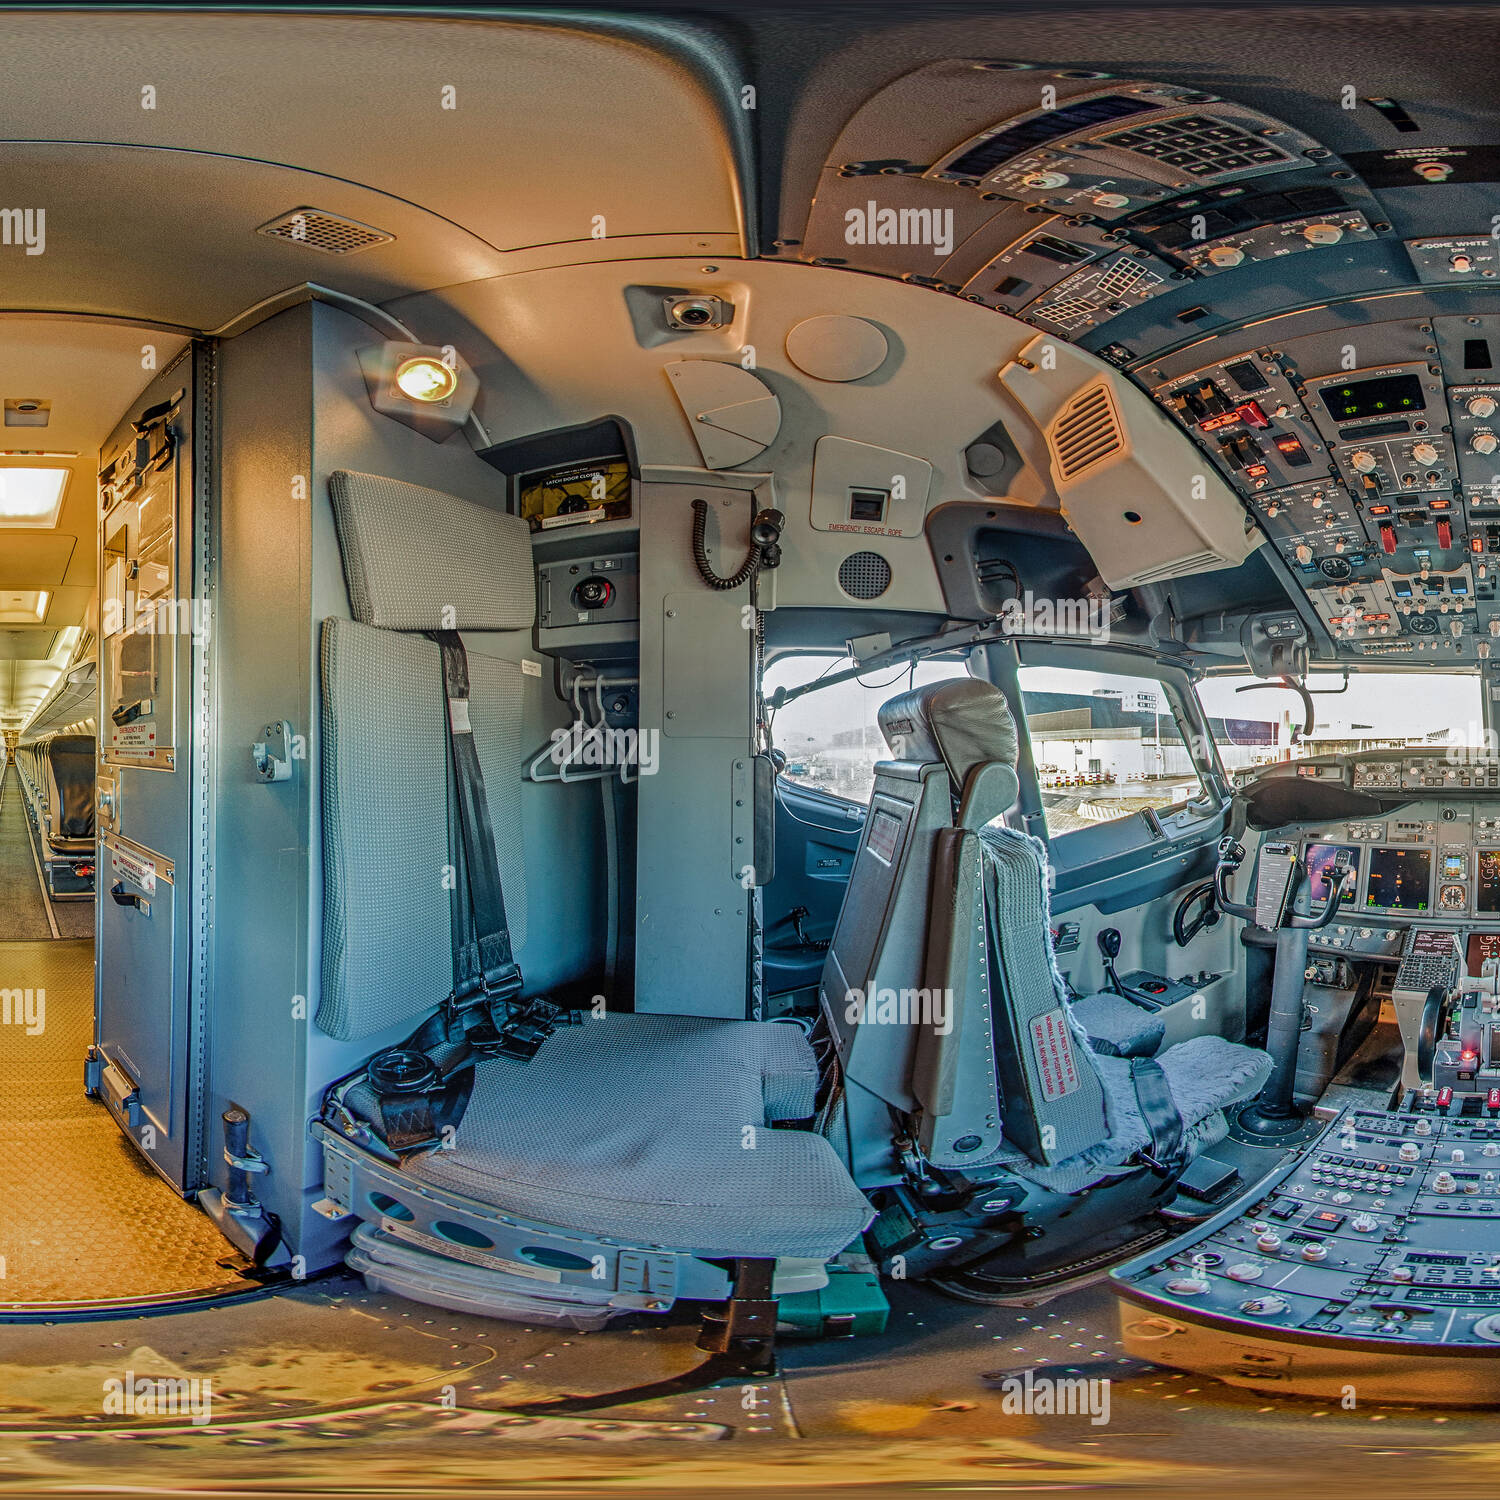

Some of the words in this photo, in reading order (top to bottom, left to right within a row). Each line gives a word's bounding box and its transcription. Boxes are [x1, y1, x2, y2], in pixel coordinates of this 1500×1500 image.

[1345, 406, 1358, 414] 27
[828, 523, 862, 533] EMERGENCY
[863, 526, 885, 535] ESCAPE
[887, 527, 903, 537] ROPE
